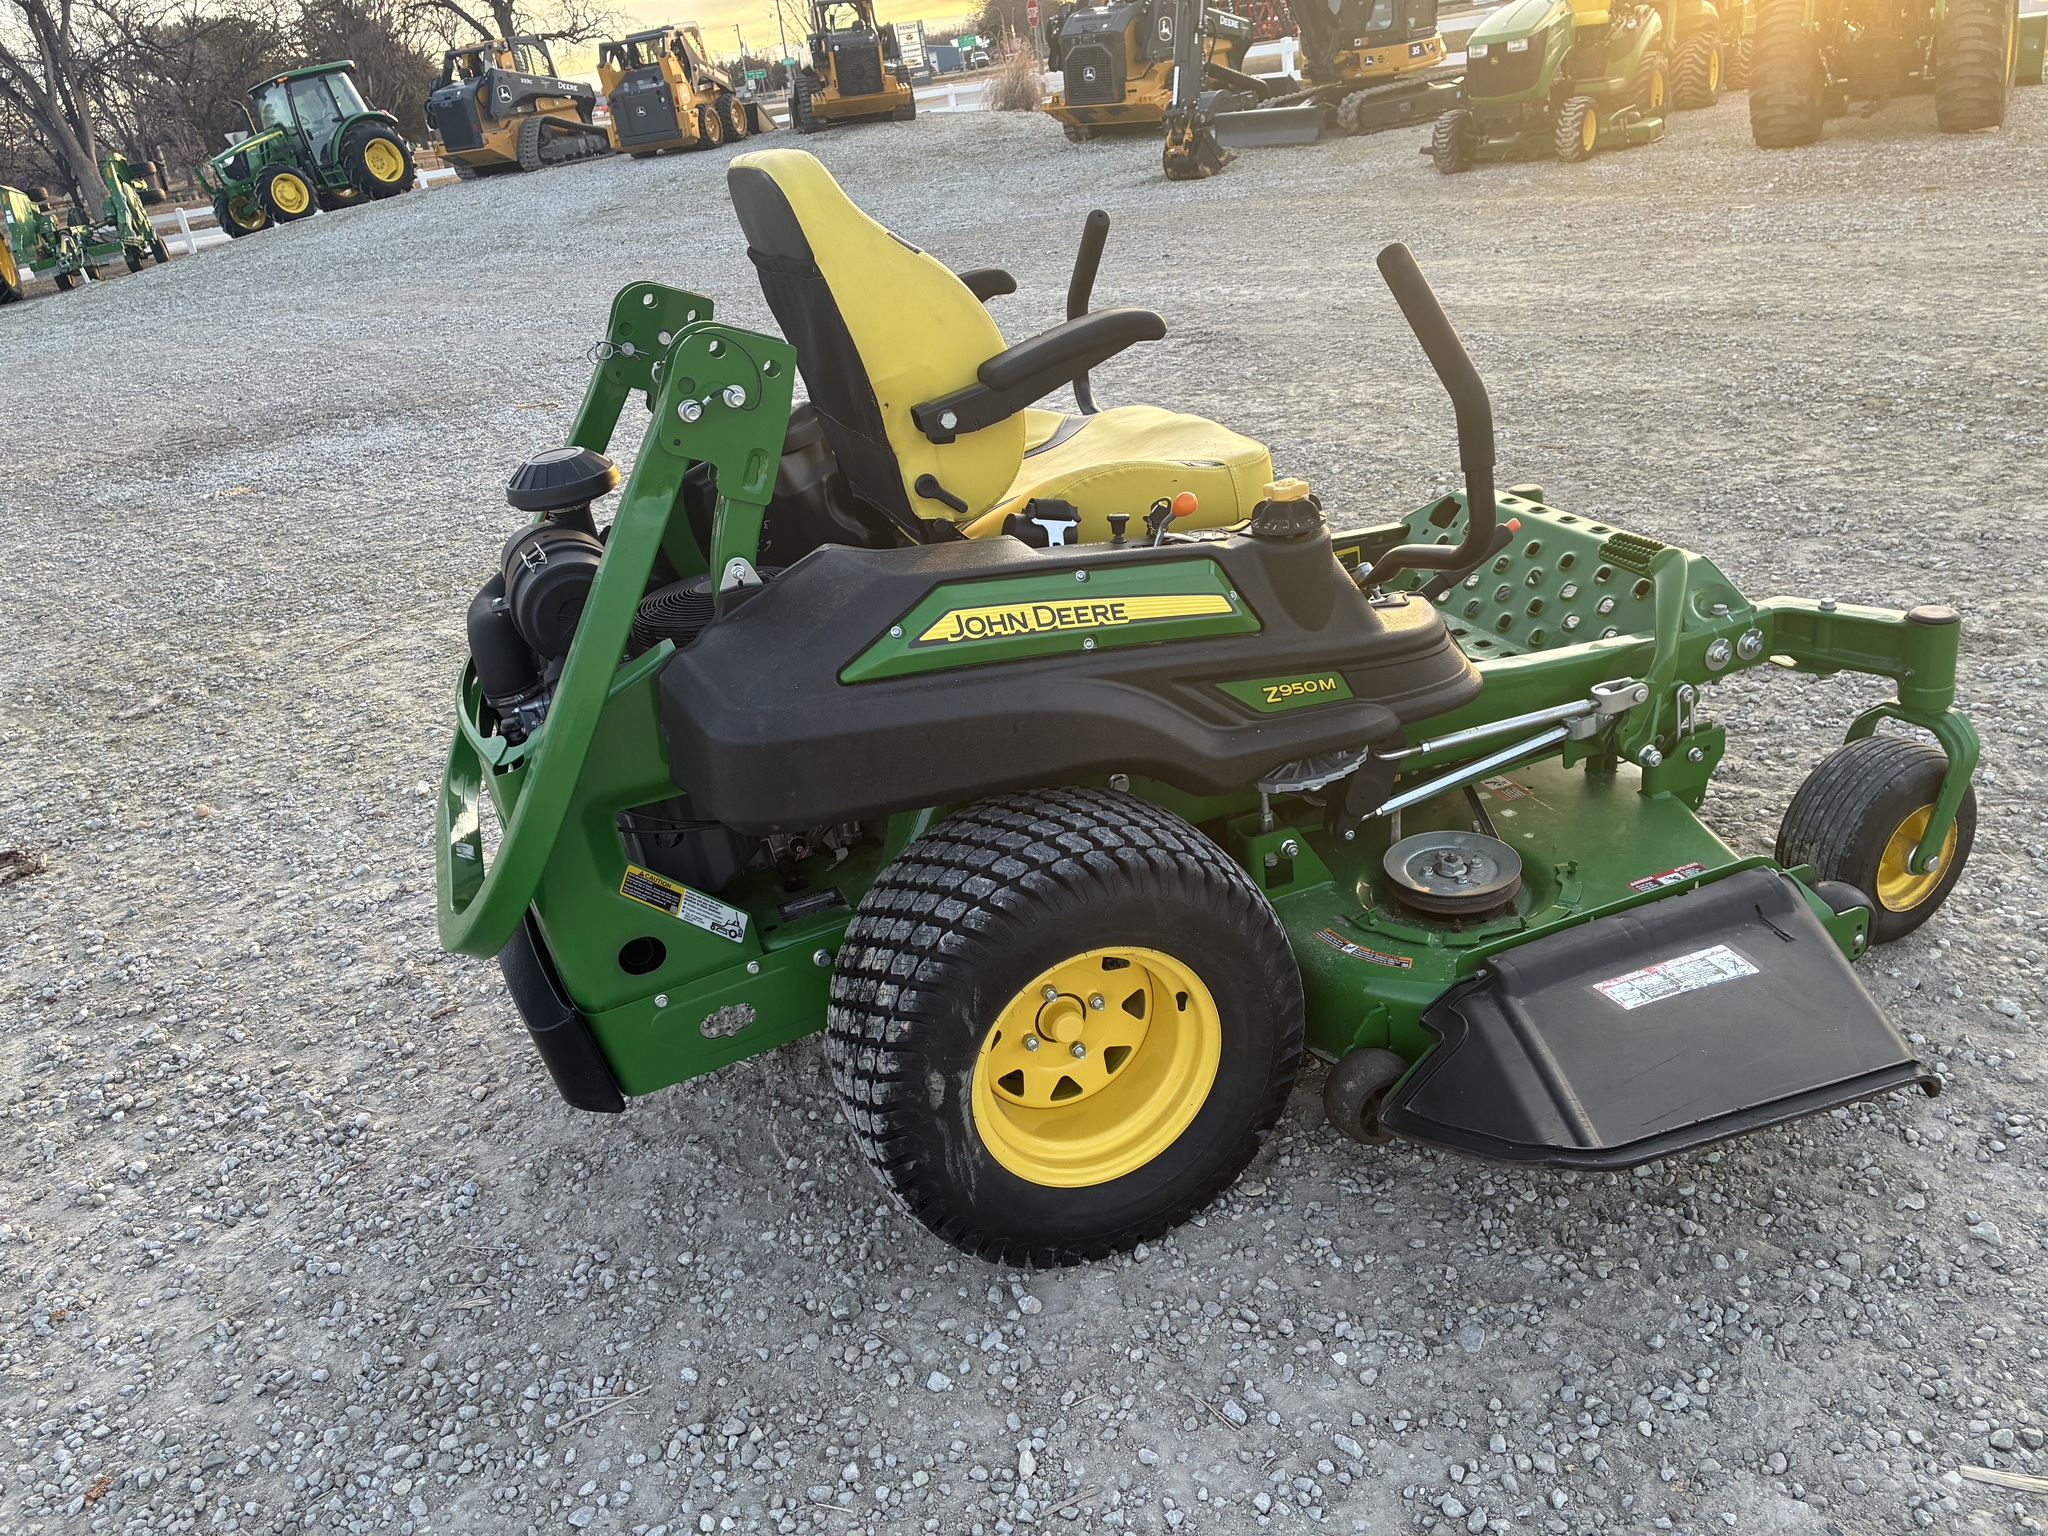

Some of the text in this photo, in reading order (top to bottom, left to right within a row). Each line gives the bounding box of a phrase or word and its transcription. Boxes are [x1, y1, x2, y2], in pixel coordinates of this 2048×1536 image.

[1027, 7, 1039, 18] STOP
[1219, 15, 1239, 29] DEERE
[1412, 45, 1421, 55] 35
[557, 81, 579, 92] DEERE
[949, 602, 1129, 639] JOHN DEERE
[1263, 677, 1337, 704] Z950M
[645, 873, 672, 889] CAUTION
